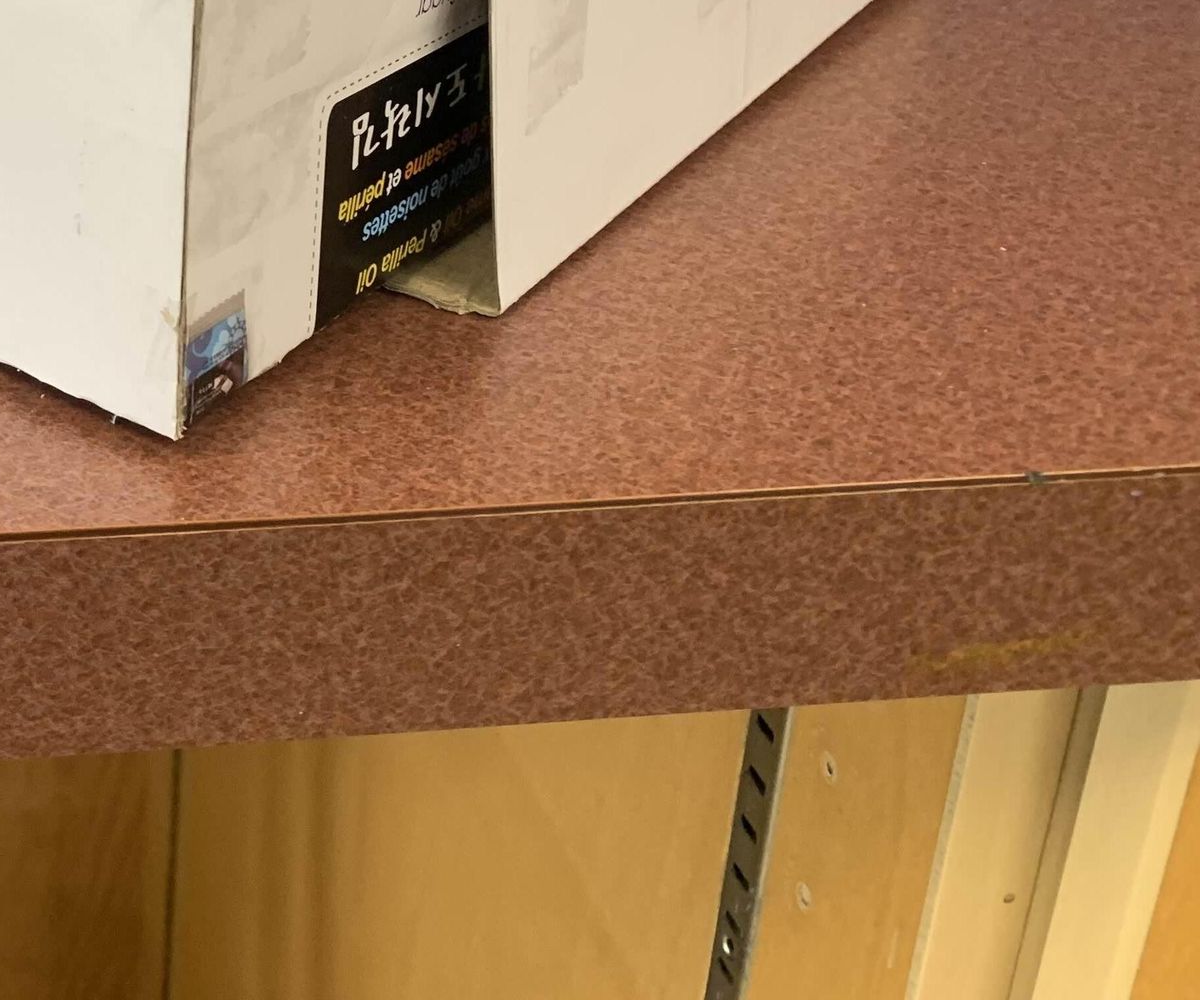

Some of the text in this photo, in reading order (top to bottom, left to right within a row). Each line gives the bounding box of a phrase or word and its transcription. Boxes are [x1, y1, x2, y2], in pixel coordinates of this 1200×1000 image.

[351, 63, 468, 171] 도시락김
[338, 171, 386, 223] périlla
[386, 168, 402, 196] et
[430, 173, 449, 199] de
[362, 185, 429, 242] noisettes
[381, 227, 428, 273] Perilla
[355, 263, 378, 295] Oil
